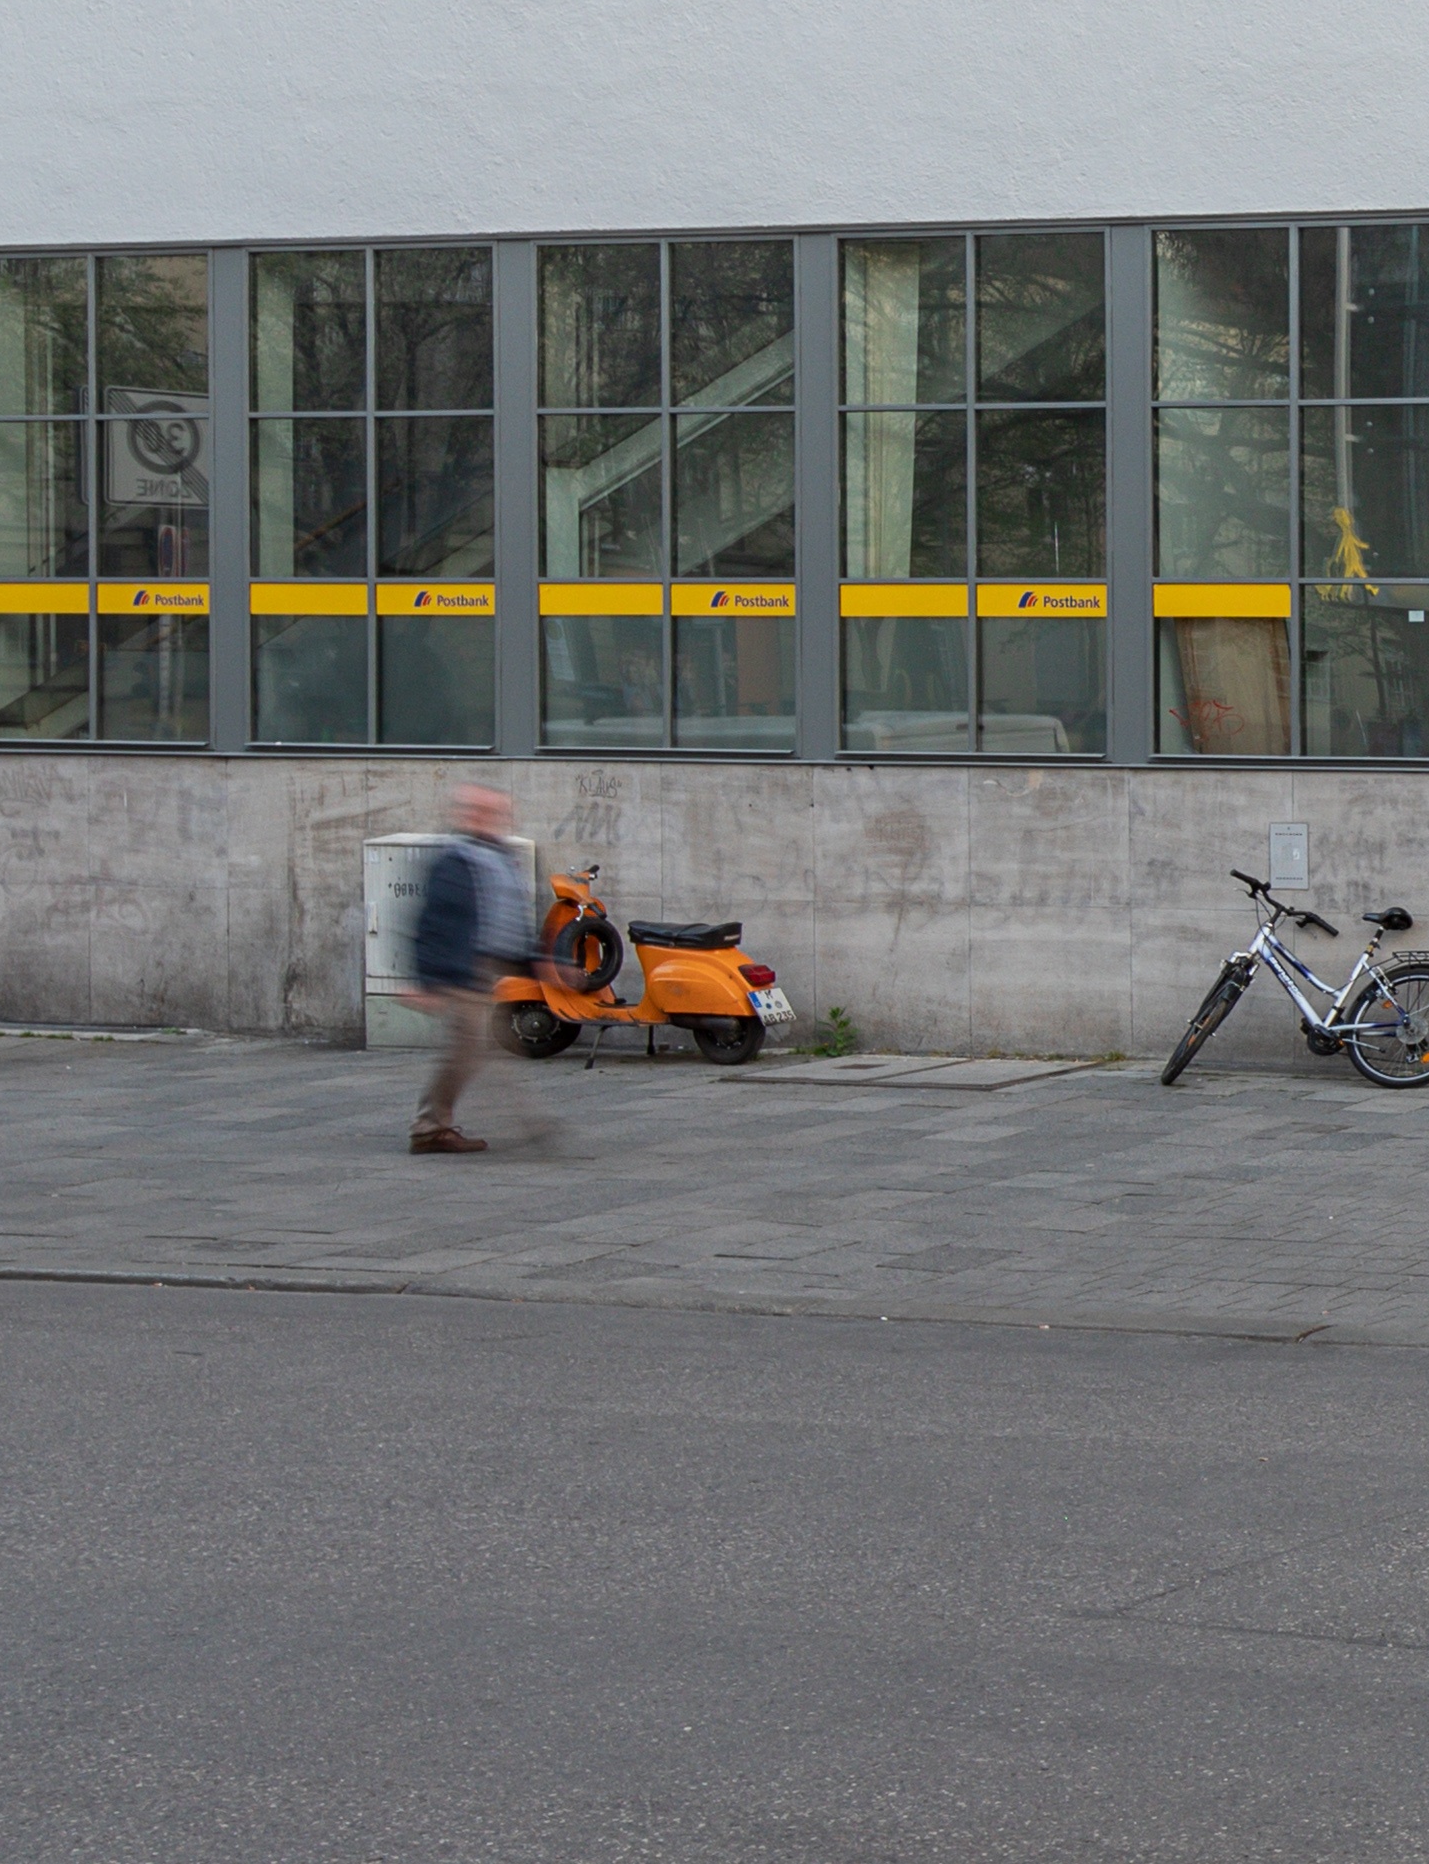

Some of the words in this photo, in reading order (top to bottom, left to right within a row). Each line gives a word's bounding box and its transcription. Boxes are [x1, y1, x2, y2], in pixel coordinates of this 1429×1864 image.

[155, 594, 204, 606] Postbank
[437, 594, 489, 607] Postbank
[735, 595, 789, 607] Postbank
[1044, 595, 1100, 608] Postbank
